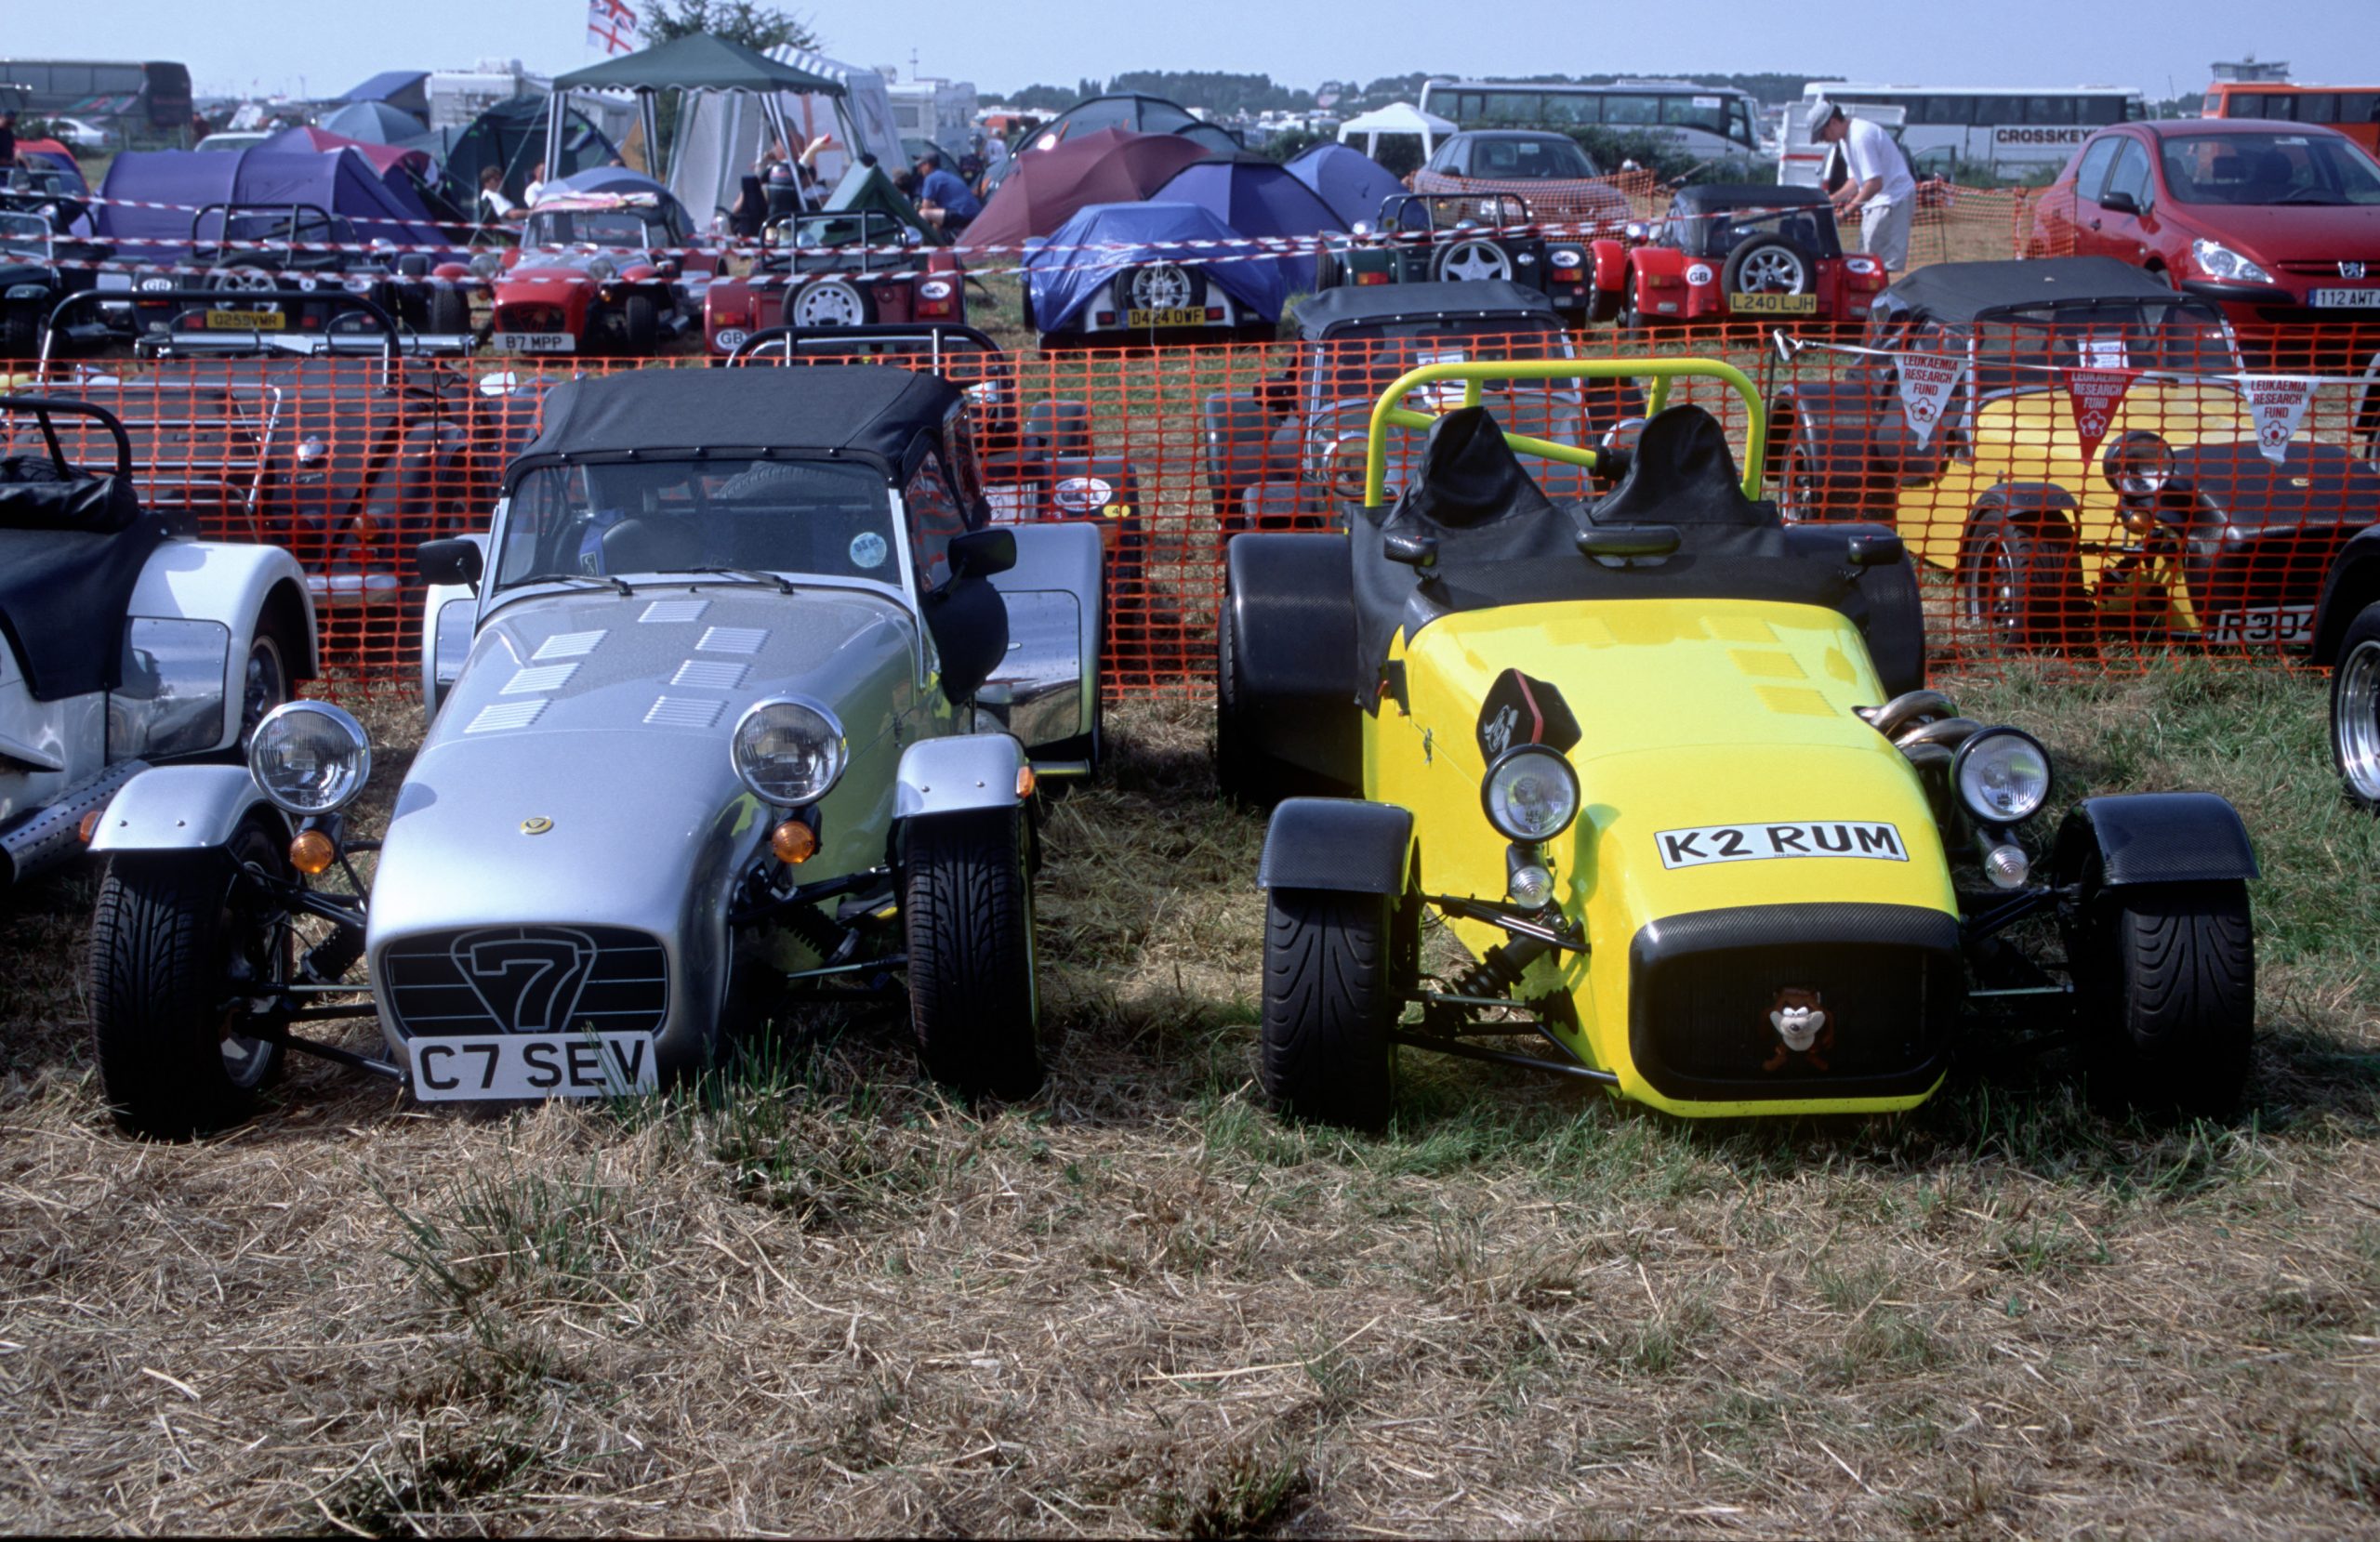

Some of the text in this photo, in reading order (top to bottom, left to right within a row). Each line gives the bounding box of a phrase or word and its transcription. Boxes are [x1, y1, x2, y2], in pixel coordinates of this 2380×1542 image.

[1996, 129, 2097, 143] CROSSKEY
[1689, 271, 1709, 283] GB
[1732, 297, 1814, 310] L240 LJH
[2321, 291, 2346, 306] 112
[2348, 291, 2375, 306] AWT
[506, 336, 562, 349] B7 MPP
[721, 331, 745, 345] GB
[1903, 355, 1958, 372] LEUKAEMIA
[1904, 368, 1953, 384] RESEARCH
[1913, 383, 1938, 396] FUND
[2073, 382, 2122, 396] RESEARCH
[2251, 380, 2307, 392] LEUKAEMIA
[2083, 397, 2109, 409] FUND
[2253, 393, 2302, 405] RESEARCH
[2264, 407, 2289, 418] FUND
[1664, 824, 1898, 863] K2 RUM
[419, 1039, 645, 1090] C7 SEV
